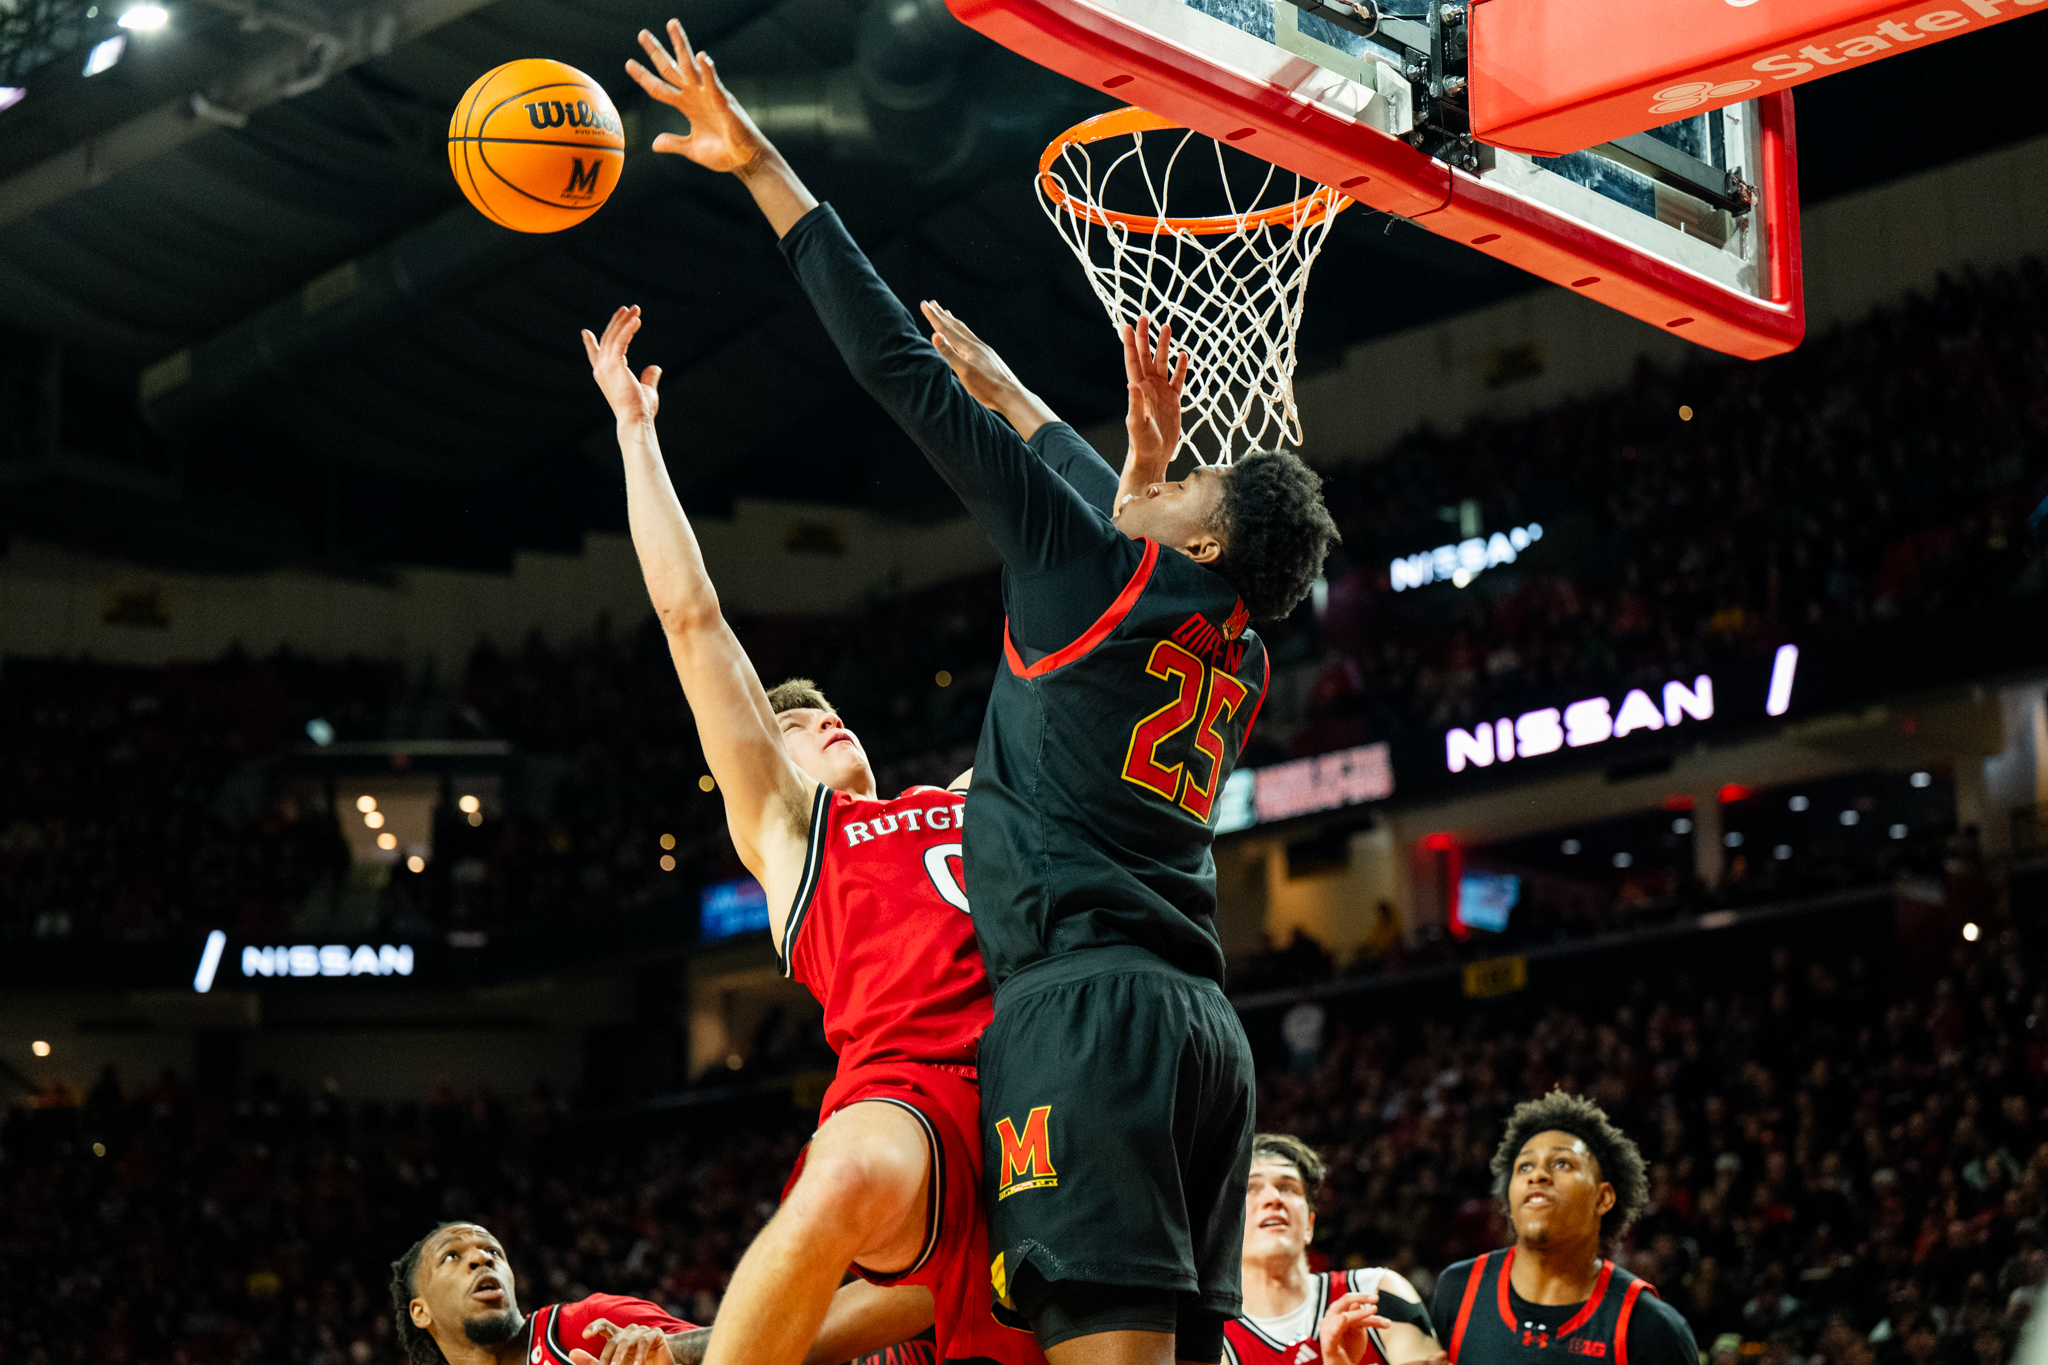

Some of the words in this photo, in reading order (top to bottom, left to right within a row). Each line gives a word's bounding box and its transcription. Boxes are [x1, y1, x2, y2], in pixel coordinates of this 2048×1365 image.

[561, 156, 604, 195] M
[1121, 640, 1248, 824] 25
[1446, 674, 1714, 773] NISSAN
[241, 944, 414, 977] NISSAN
[995, 1105, 1057, 1190] M
